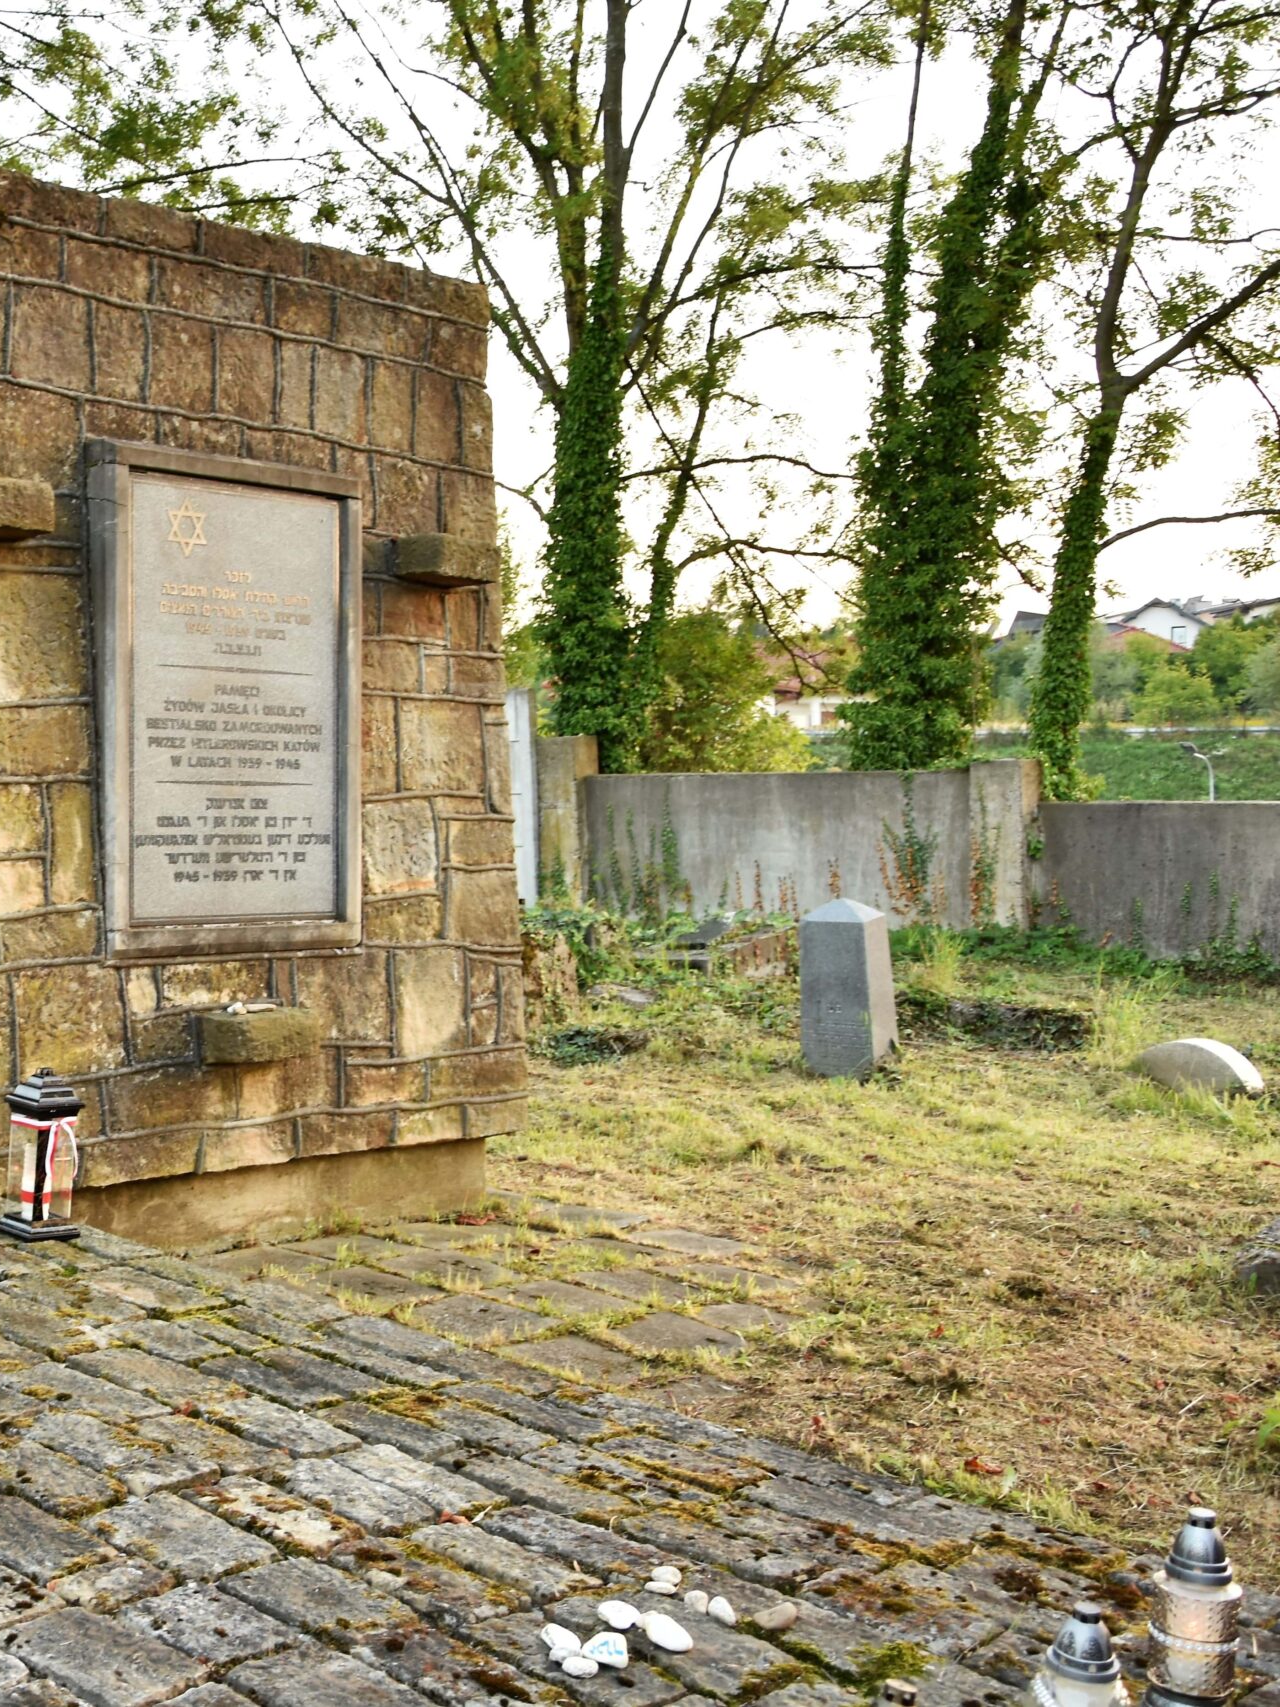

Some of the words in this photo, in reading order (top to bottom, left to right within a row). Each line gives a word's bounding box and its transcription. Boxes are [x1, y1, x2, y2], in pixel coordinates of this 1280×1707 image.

[214, 684, 260, 700] PAMIĘCI
[163, 697, 205, 713] ŻYDÓW
[211, 702, 249, 715] JASŁA
[263, 705, 306, 717] OKOLICY
[146, 718, 216, 731] BESTIALSKO
[222, 720, 322, 735] ZAMORDOWANYCH
[148, 736, 186, 749] PRZEZ
[191, 737, 279, 751] HITLEROWSKICH
[283, 739, 321, 752] KATÓW
[170, 755, 182, 767] W
[187, 756, 232, 768] LATACH
[239, 756, 262, 769] 1939
[276, 758, 301, 770] 1945
[174, 871, 200, 882] 1945
[213, 869, 238, 882] 1939
